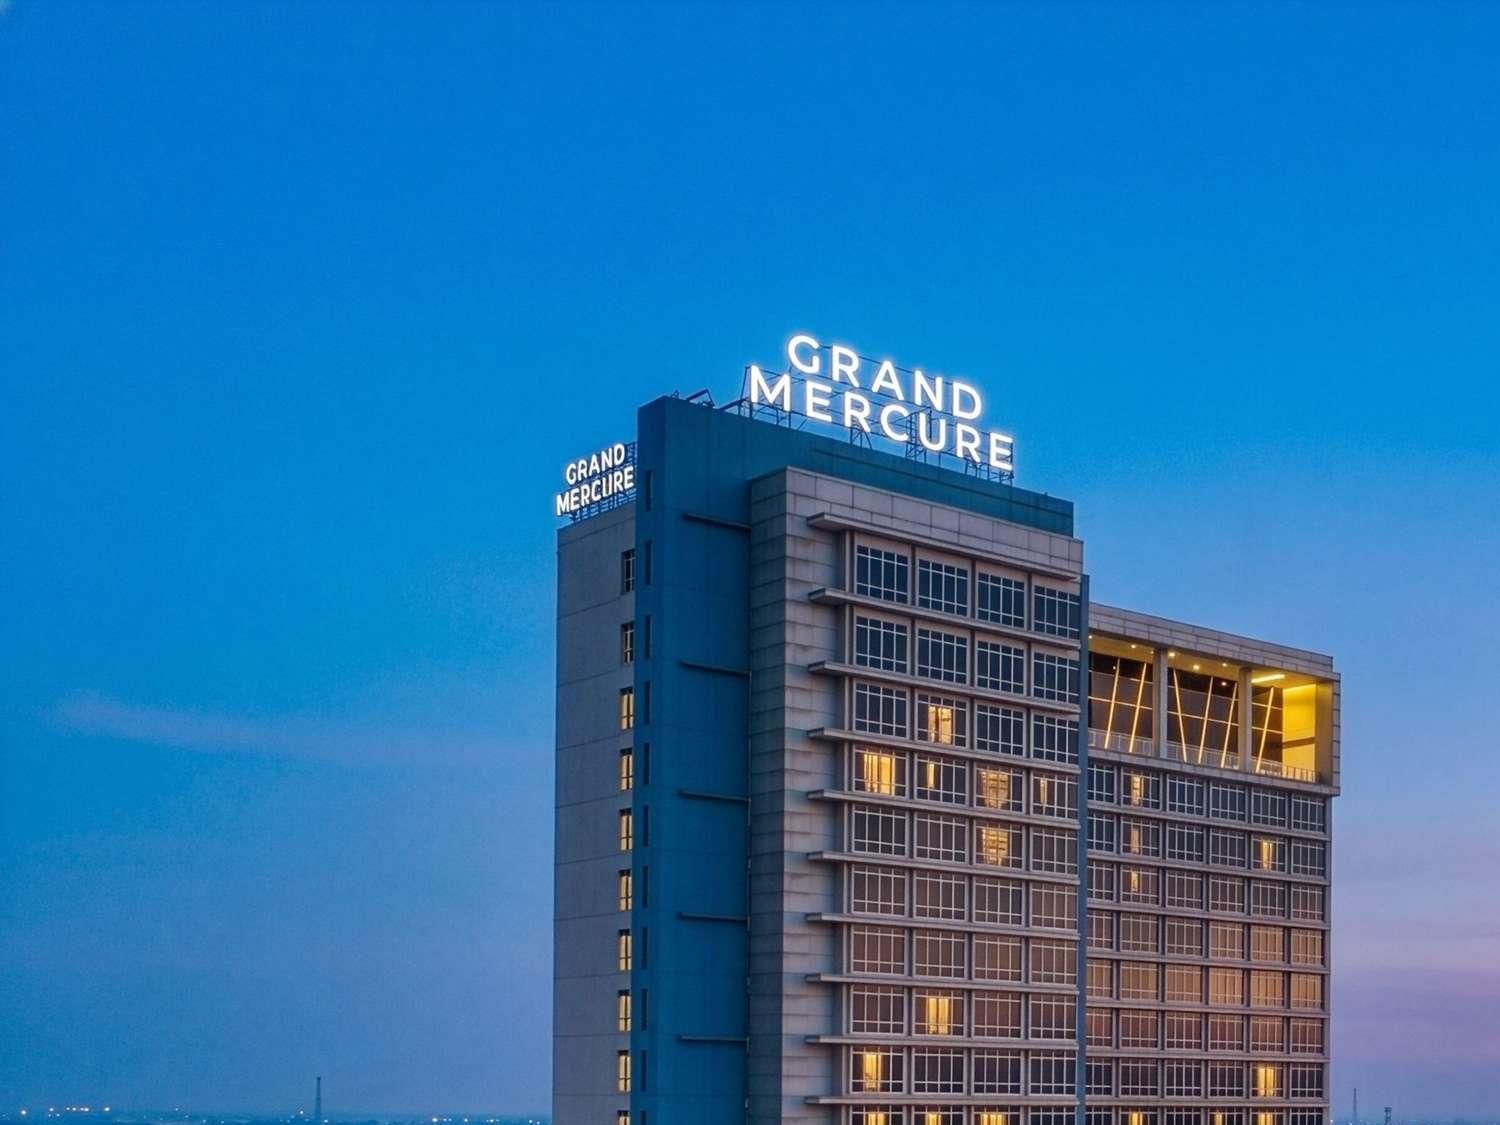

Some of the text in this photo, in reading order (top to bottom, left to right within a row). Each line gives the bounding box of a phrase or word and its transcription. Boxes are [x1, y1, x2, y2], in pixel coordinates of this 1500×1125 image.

[787, 334, 983, 420] GRAND
[749, 365, 1014, 471] MERCURE
[556, 464, 635, 516] MERCURE
[565, 443, 626, 485] GRAND
